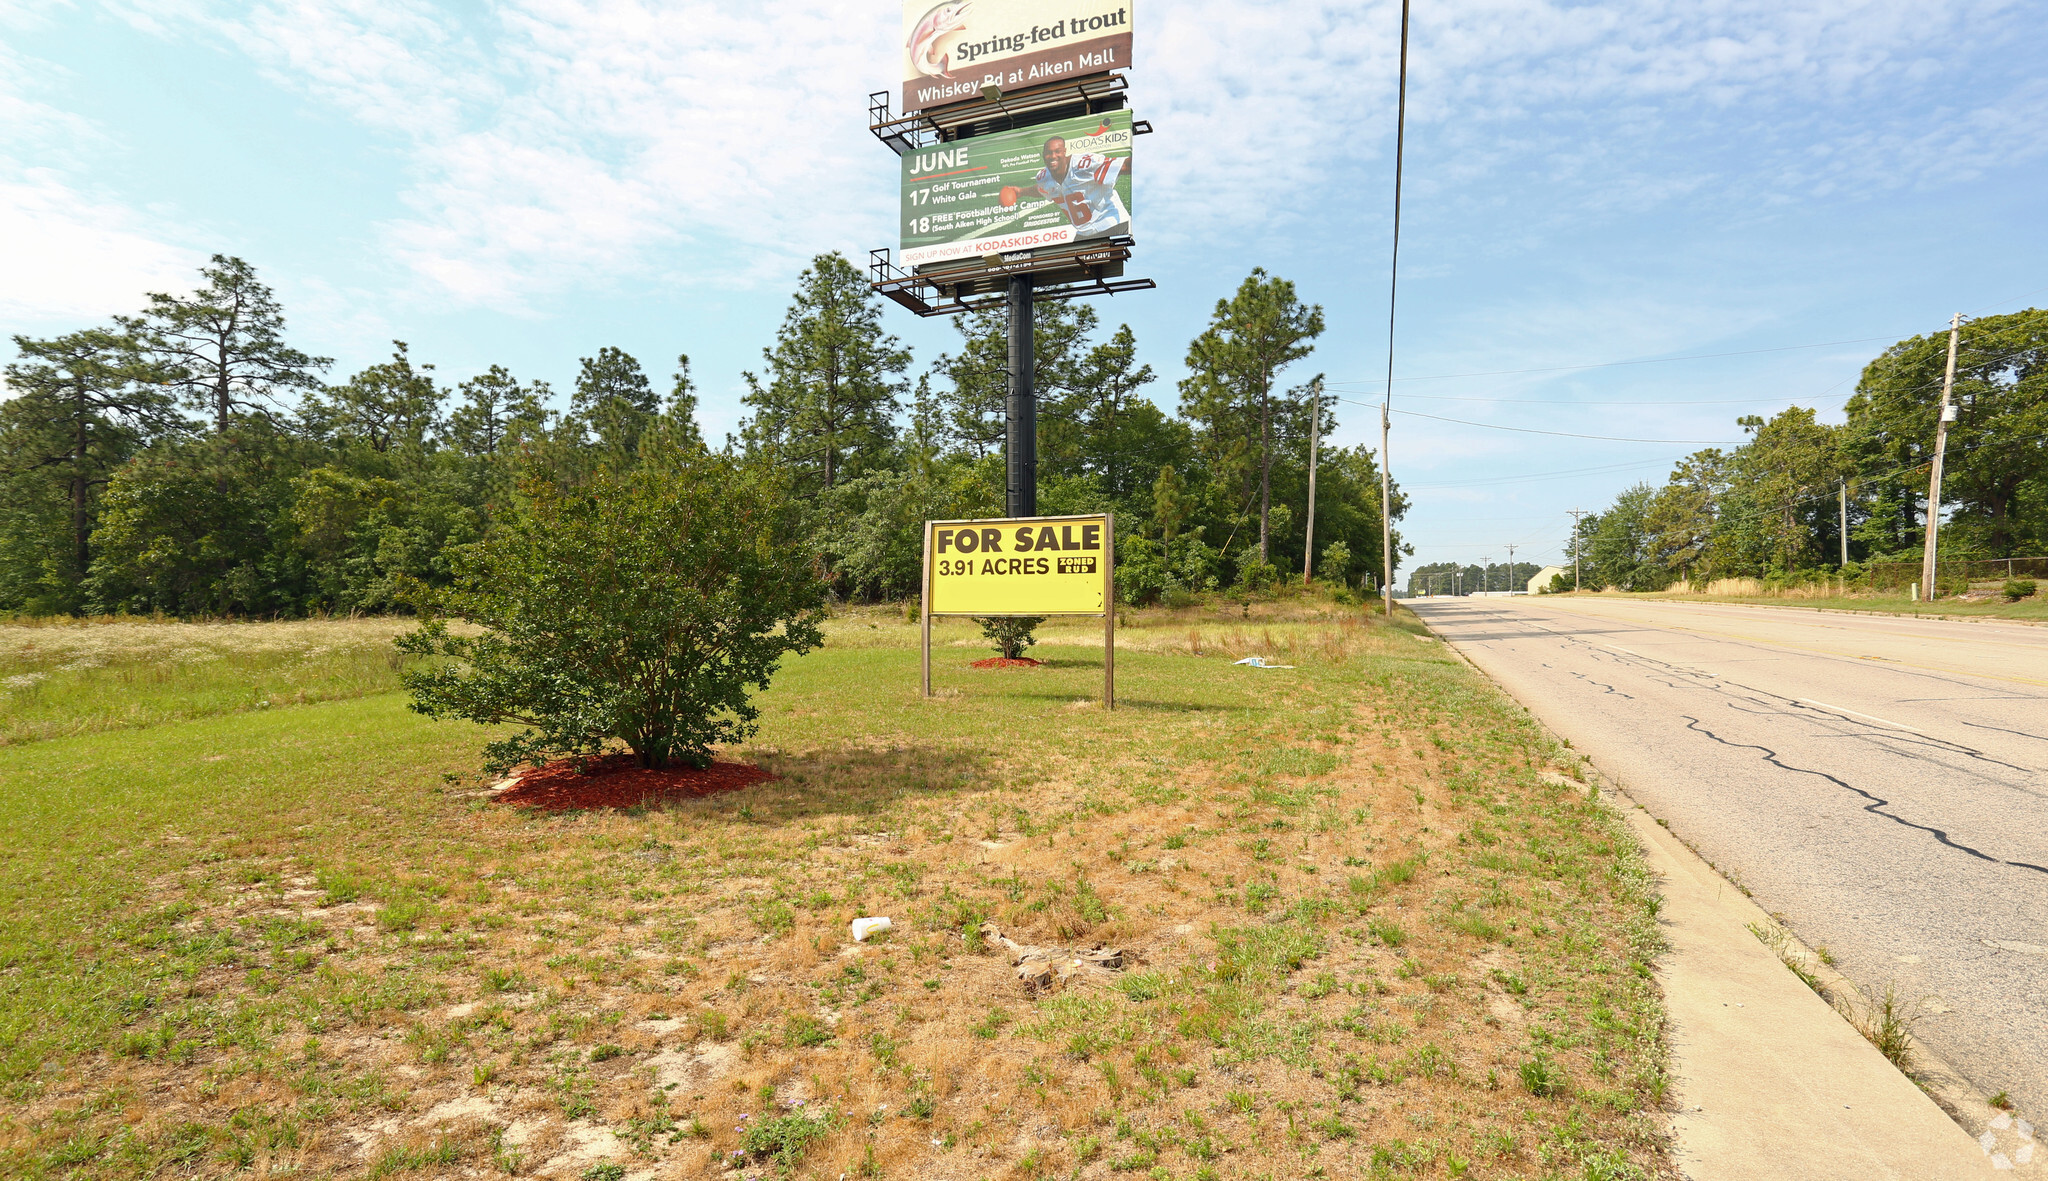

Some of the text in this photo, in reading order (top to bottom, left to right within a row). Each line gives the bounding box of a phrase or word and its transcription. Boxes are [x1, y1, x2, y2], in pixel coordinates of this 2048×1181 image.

[957, 7, 1126, 61] Spring-fed trout
[917, 79, 979, 103] Whiskey
[1008, 71, 1024, 85] at
[1028, 59, 1073, 79] Aiken
[1079, 48, 1115, 68] Mall
[1105, 132, 1128, 143] KIDS
[910, 146, 969, 175] JUNE
[932, 175, 1001, 194] Golf Tournament
[909, 188, 930, 207] 17
[932, 190, 977, 205] White Gala
[932, 199, 1045, 224] FREE Football/Cheer Camp
[909, 217, 930, 235] 18
[932, 212, 1019, 233] (South Aiken High School)
[905, 230, 1068, 262] SIGN UP NOW AT KODASKIDS.ORG
[938, 525, 1100, 554] FOR SALE
[939, 557, 1049, 576] 3.91 ACRES
[1059, 557, 1094, 565] ZONED
[1065, 565, 1089, 573] RUD
